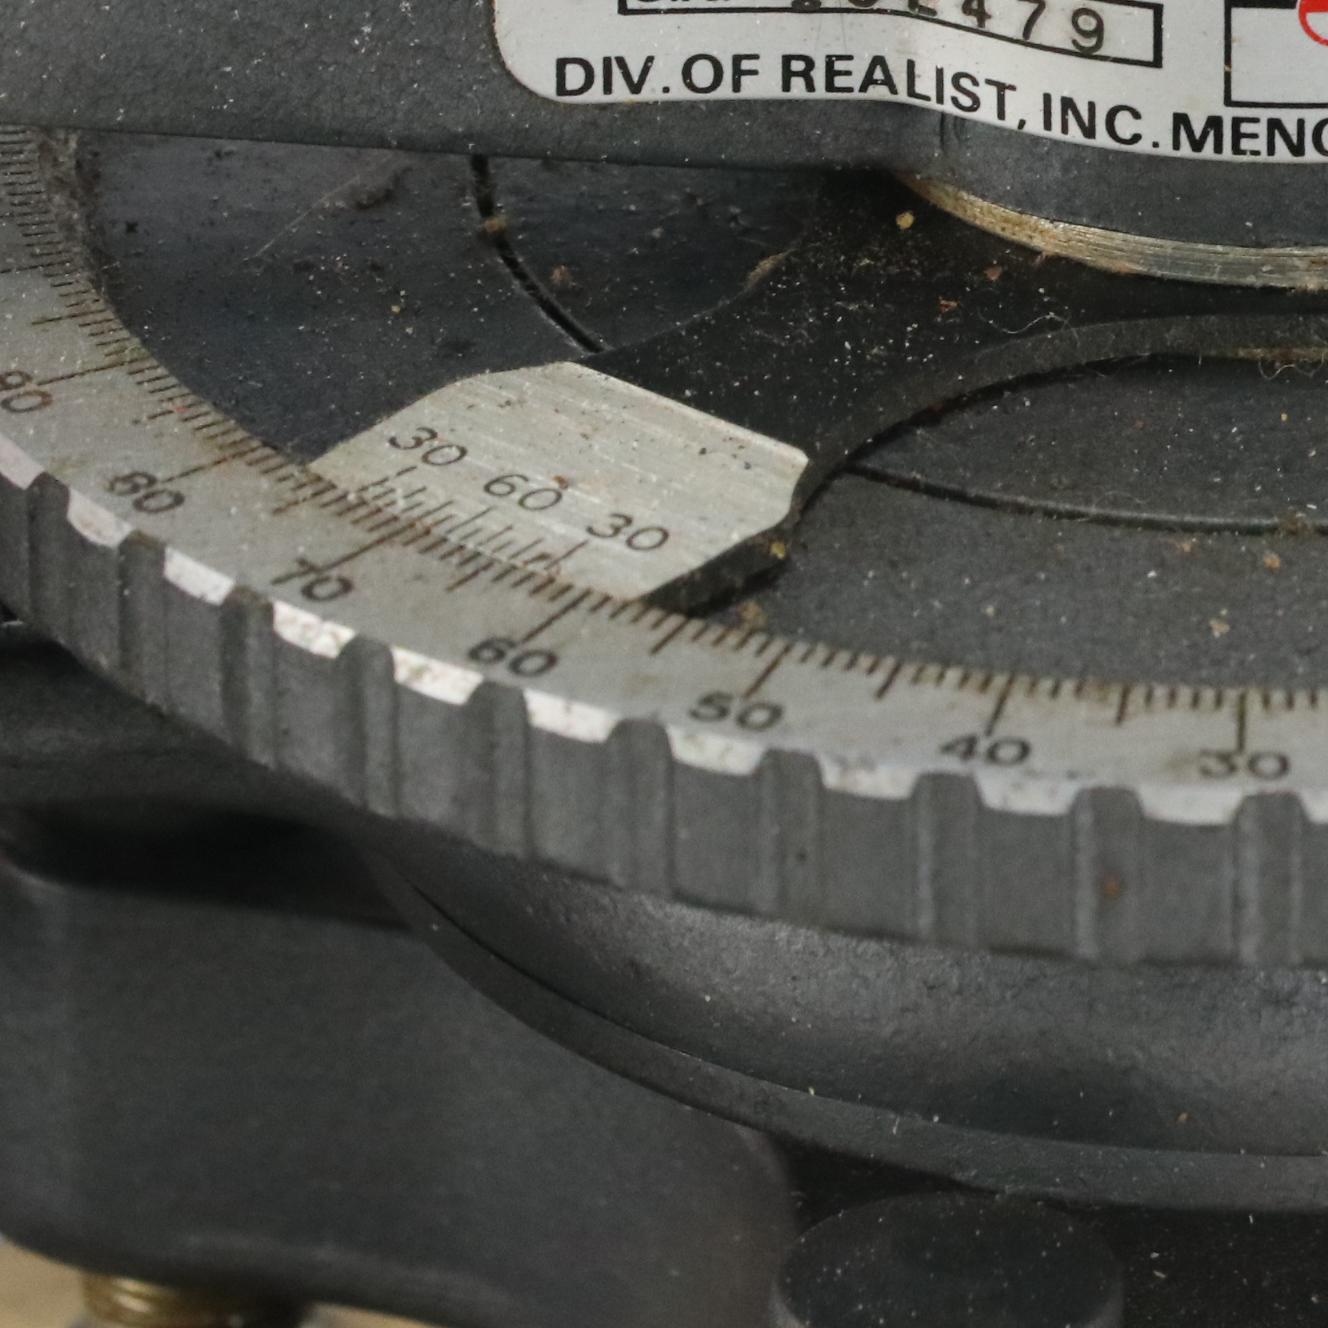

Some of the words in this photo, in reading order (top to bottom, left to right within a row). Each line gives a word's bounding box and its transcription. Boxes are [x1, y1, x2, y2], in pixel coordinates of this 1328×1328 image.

[555, 55, 671, 98] DIV.
[681, 53, 761, 95] OF
[781, 53, 1027, 132] REALIST,
[1042, 91, 1160, 149] INC.
[387, 425, 468, 467] 30
[482, 472, 563, 512] 60
[585, 512, 671, 552] 30
[270, 556, 354, 602] 70
[467, 635, 558, 678] 60
[688, 690, 784, 732] 50
[940, 734, 1032, 767] 40
[1198, 747, 1291, 780] 30
